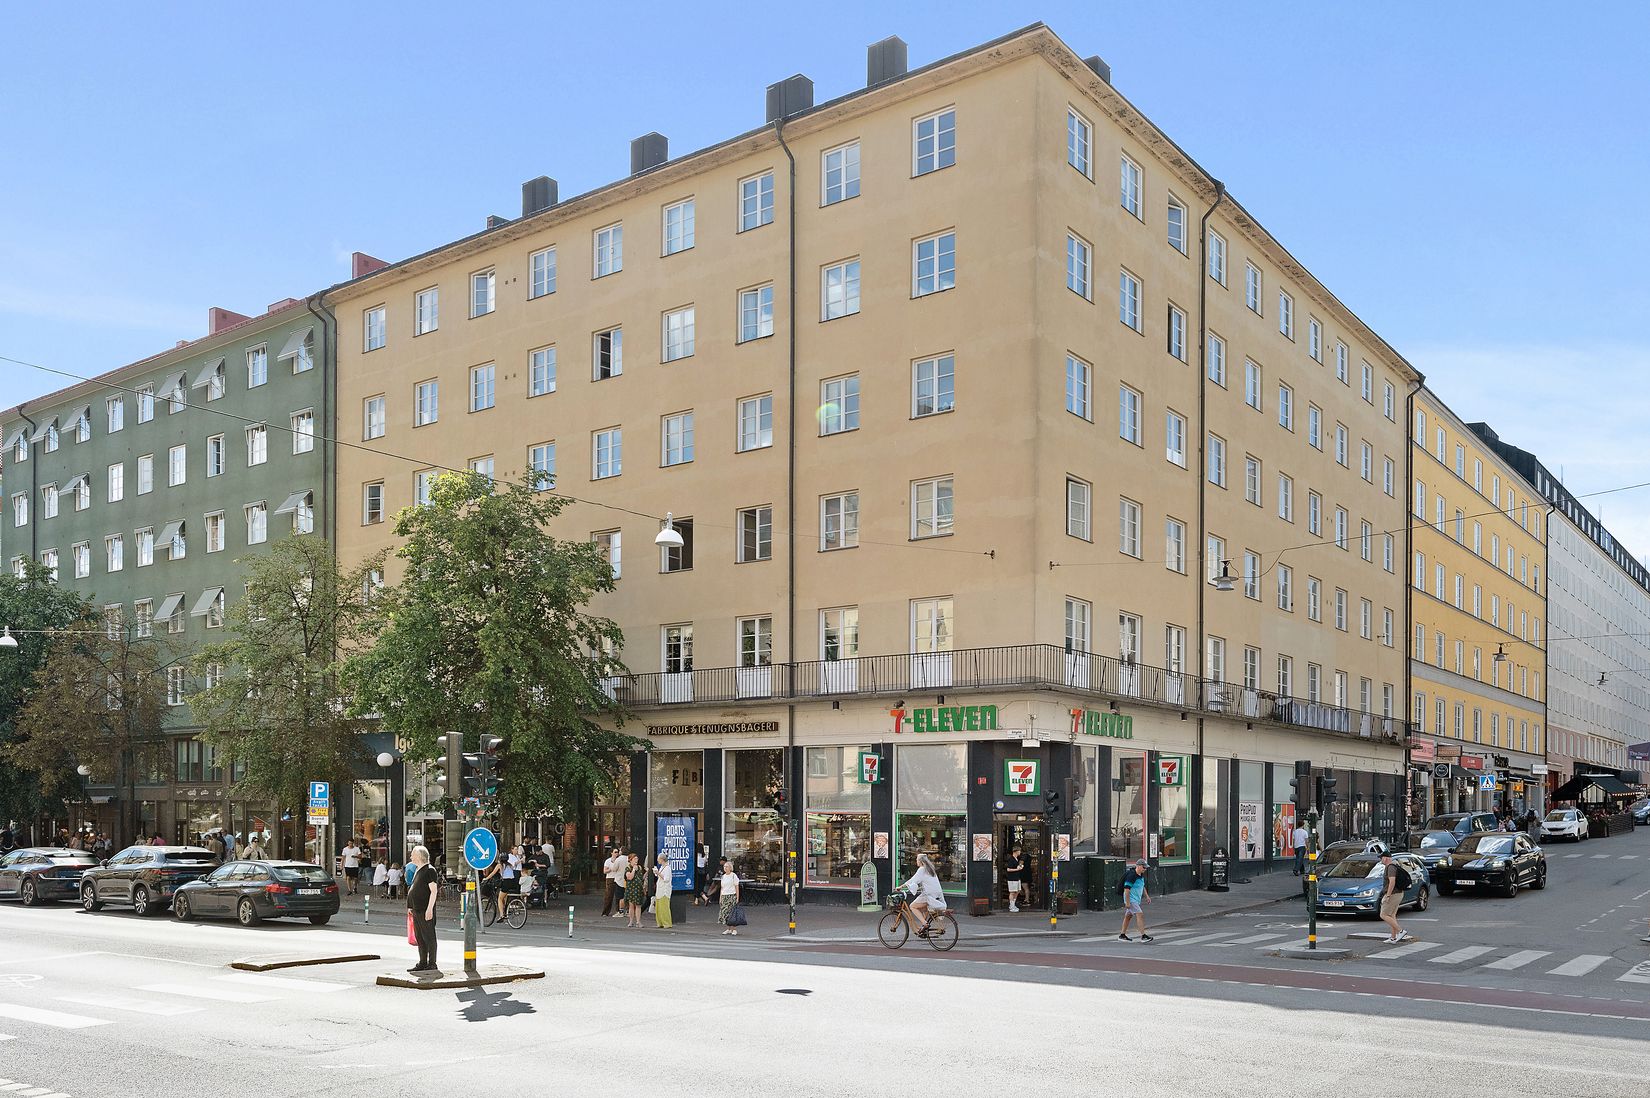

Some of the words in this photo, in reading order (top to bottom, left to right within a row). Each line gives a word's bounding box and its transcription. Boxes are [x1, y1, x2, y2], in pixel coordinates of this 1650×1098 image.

[647, 725, 689, 736] FABRIQUE
[691, 722, 775, 734] STENUGNSBAGERI
[315, 783, 325, 798] P
[666, 825, 685, 836] BOATS
[664, 836, 687, 848] PHOTOS
